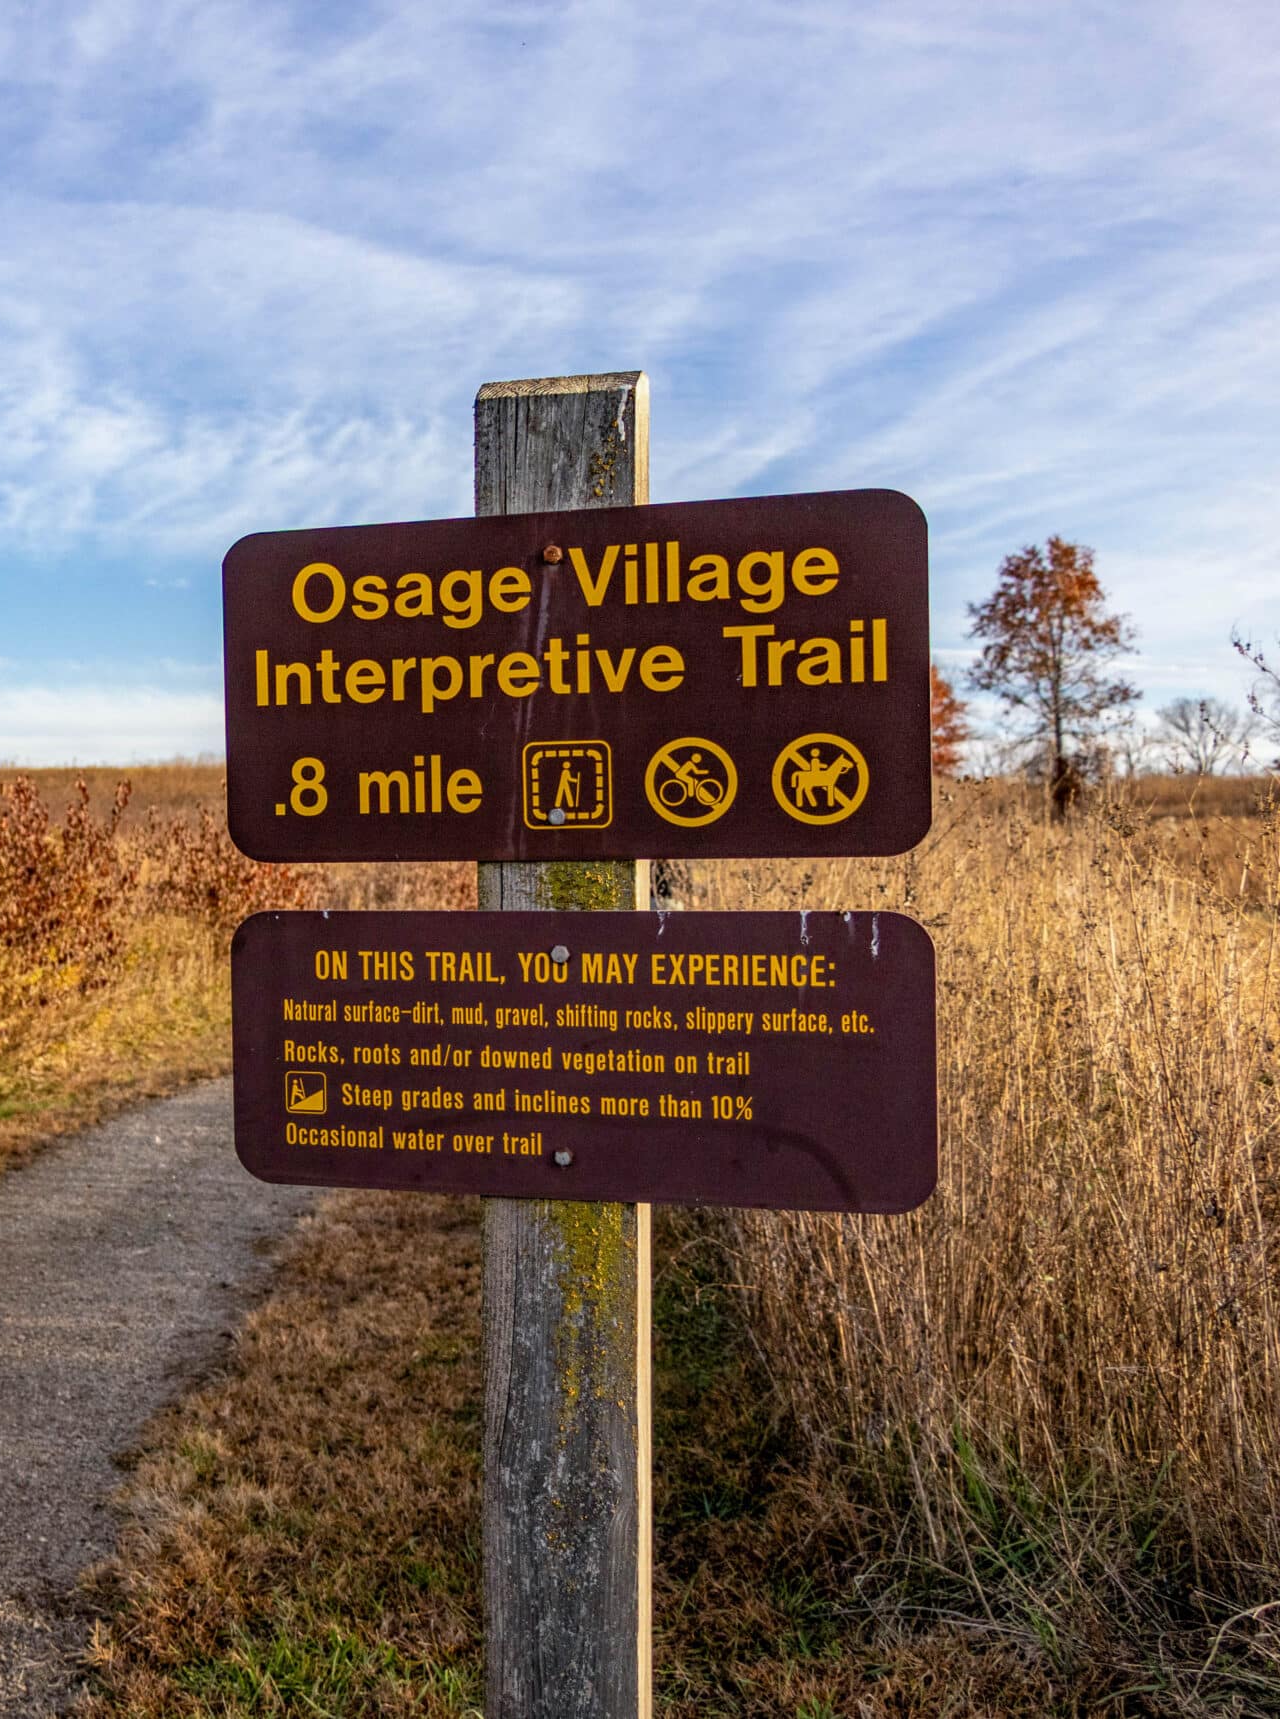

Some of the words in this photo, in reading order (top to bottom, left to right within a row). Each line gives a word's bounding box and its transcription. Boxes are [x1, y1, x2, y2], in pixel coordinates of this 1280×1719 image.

[291, 562, 533, 630] Osage
[567, 540, 841, 614] Village
[255, 633, 686, 714] Interpretive
[722, 617, 888, 688] Trail
[275, 756, 329, 817] .8
[358, 754, 484, 815] mile
[314, 949, 348, 981] ON
[357, 950, 415, 982] THIS
[424, 951, 506, 985] TRAIL,
[517, 951, 569, 984] YOU
[581, 952, 639, 985] MAY
[651, 953, 836, 988] EXPERIENCE:
[283, 998, 337, 1022] Natural
[451, 1001, 489, 1027] mud,
[495, 1002, 549, 1030] gravel,
[555, 1003, 619, 1033] shifting
[625, 1004, 679, 1031] rocks,
[685, 1006, 755, 1035] slippery
[761, 1007, 834, 1035] surface,
[840, 1009, 875, 1034] etc.
[283, 1039, 345, 1065] Rocks,
[353, 1042, 401, 1066] roots
[409, 1043, 473, 1068] and/or
[479, 1044, 553, 1070] downed
[561, 1048, 666, 1076] vegetation
[674, 1055, 698, 1074] on
[706, 1051, 751, 1076] trail
[341, 1082, 393, 1111] Steep
[401, 1086, 465, 1112] grades
[472, 1087, 506, 1112] and
[514, 1088, 591, 1115] inclines
[600, 1096, 650, 1117] more
[658, 1093, 703, 1119] than
[711, 1095, 753, 1121] 10%
[285, 1122, 384, 1149] Occasional
[391, 1128, 445, 1152] water
[452, 1134, 495, 1153] over
[502, 1131, 543, 1156] trail
